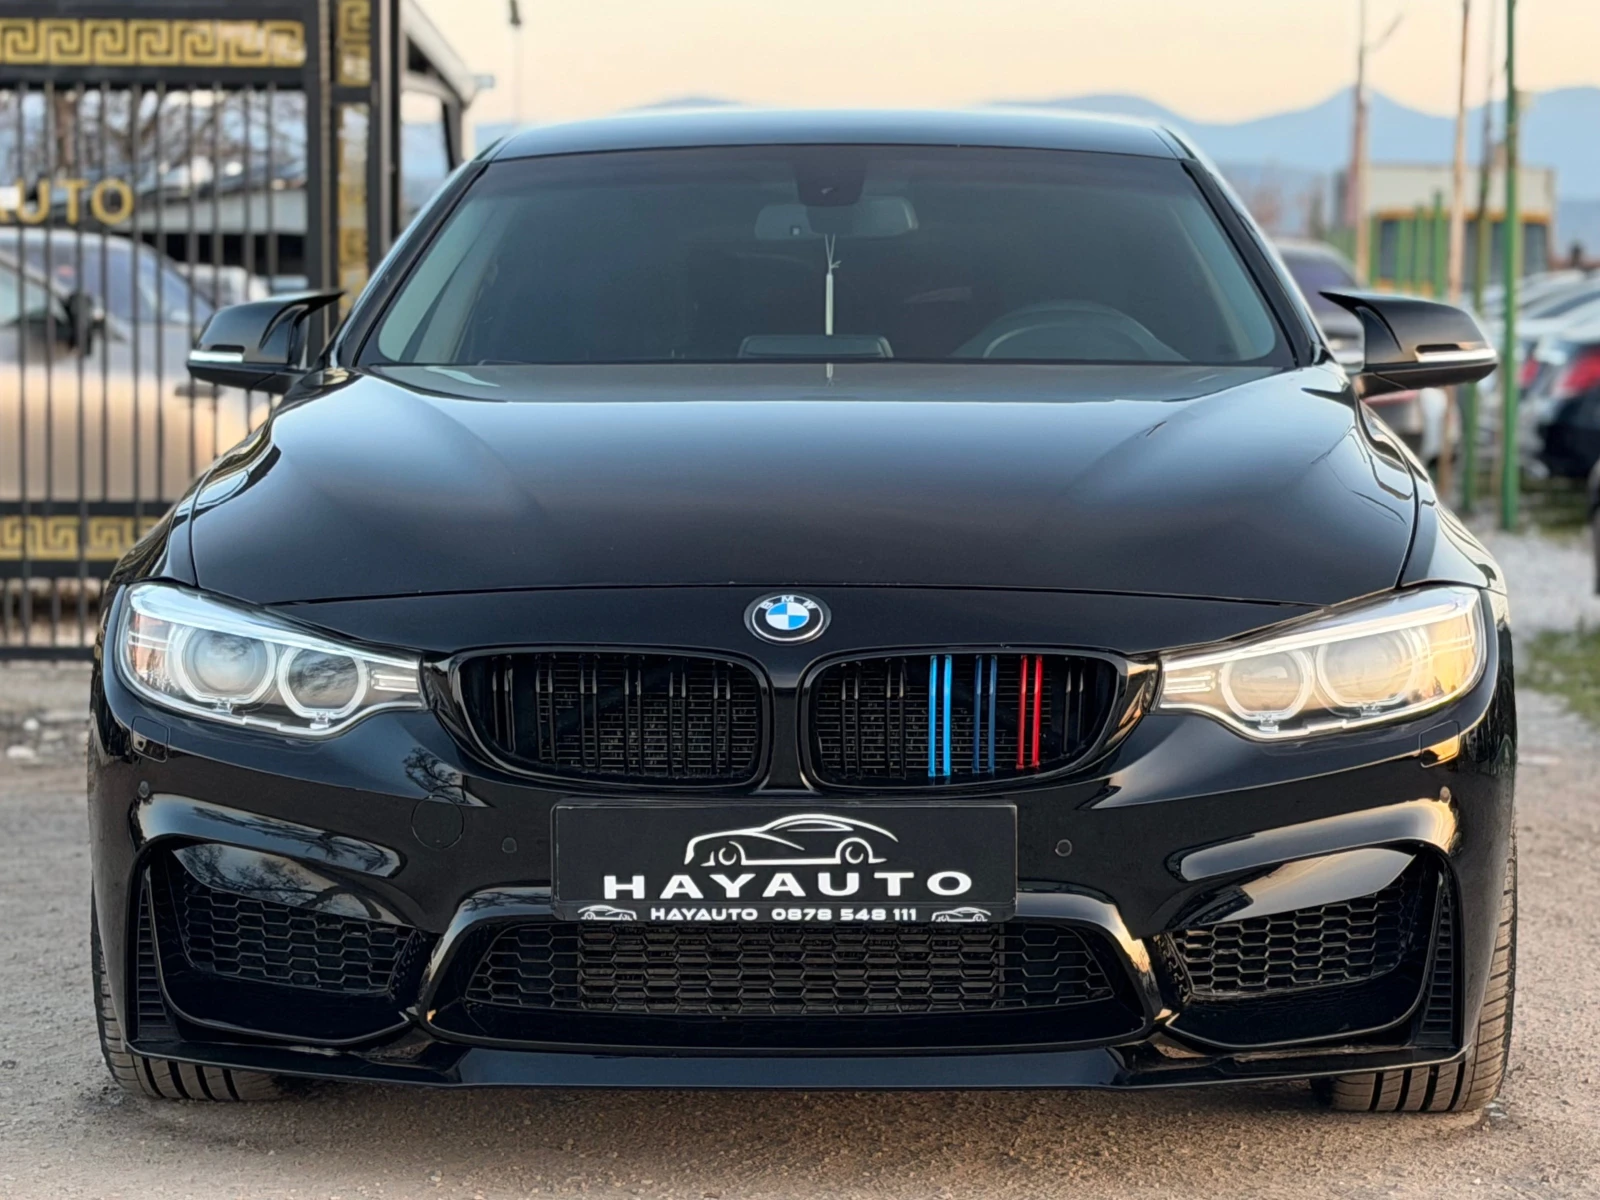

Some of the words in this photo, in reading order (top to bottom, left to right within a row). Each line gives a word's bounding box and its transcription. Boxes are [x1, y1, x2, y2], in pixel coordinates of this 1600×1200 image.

[759, 595, 818, 610] BMW
[603, 871, 973, 900] HAYAUTO
[650, 907, 759, 921] HAYAUTO
[771, 907, 833, 921] 0878
[839, 907, 887, 921] 548
[892, 908, 917, 921] 111
